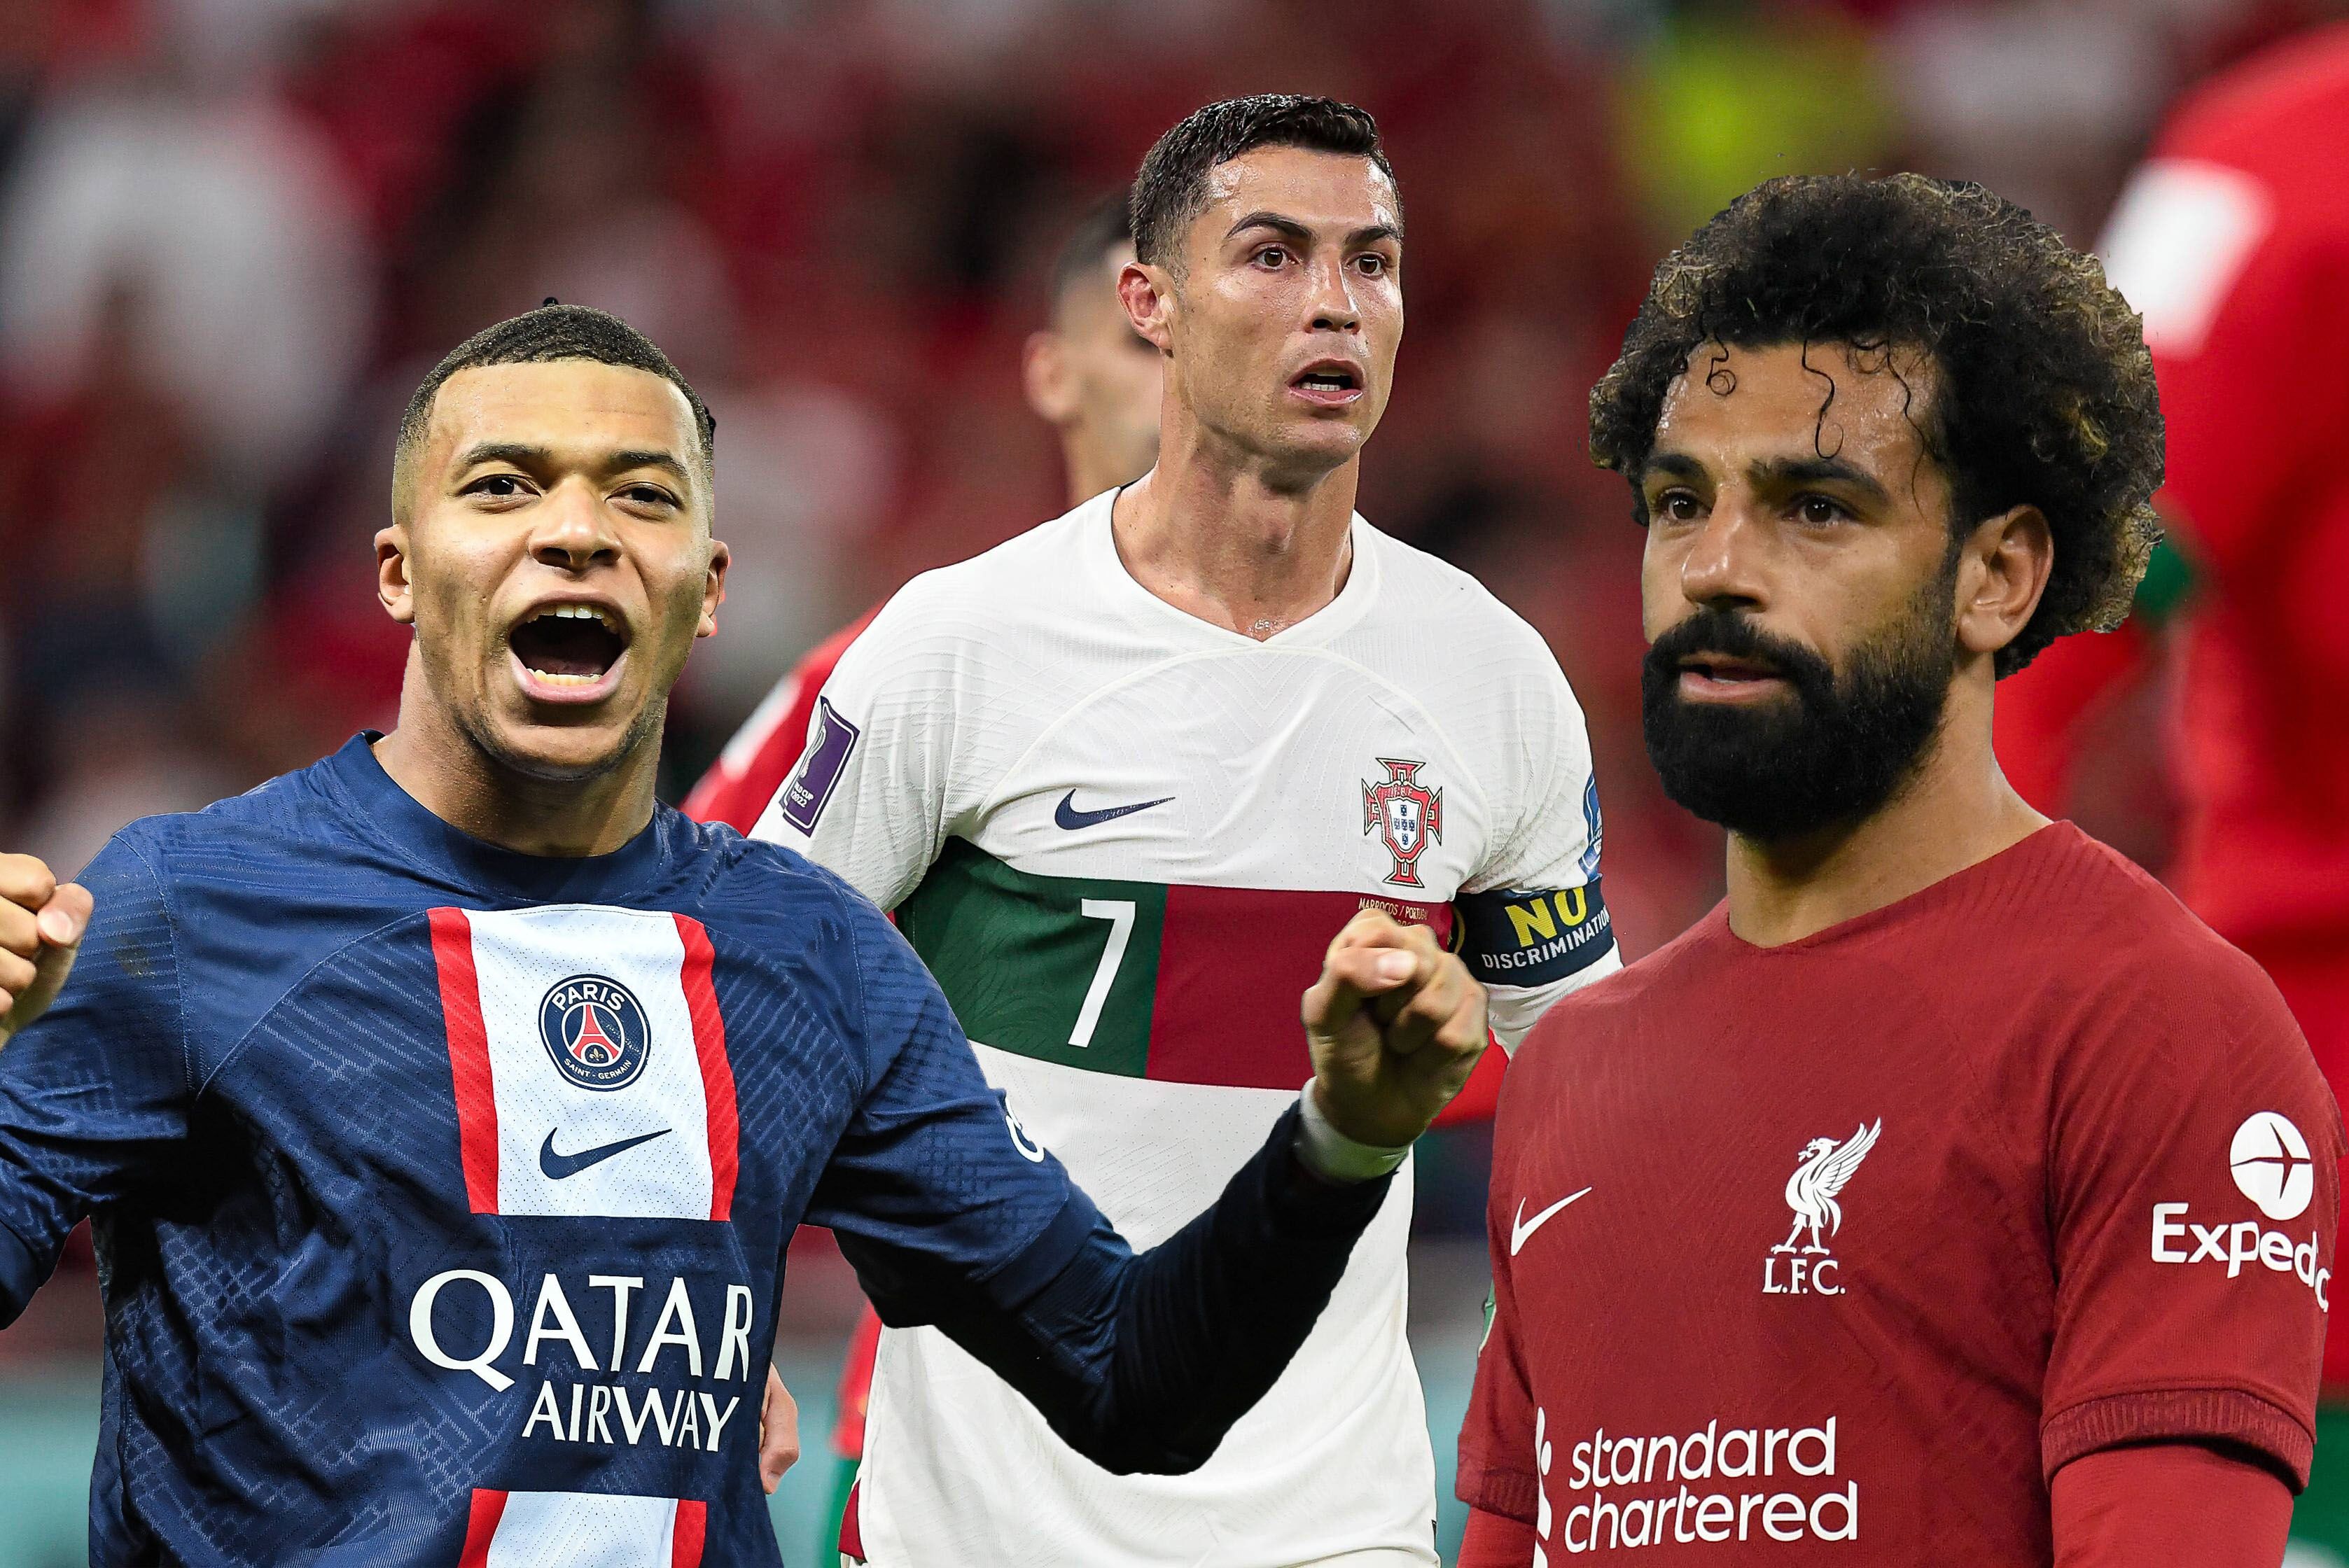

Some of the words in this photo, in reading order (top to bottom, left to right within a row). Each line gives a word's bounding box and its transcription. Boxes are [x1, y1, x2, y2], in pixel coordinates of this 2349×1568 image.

[1404, 906, 1428, 920] PORTU
[1482, 905, 1610, 969] DISCRIMINATION
[1505, 887, 1587, 947] NO
[552, 983, 625, 1011] PARIS
[1068, 898, 1136, 1048] 7
[1762, 1257, 1846, 1296] L.F.C.
[2152, 1202, 2331, 1313] Expeda
[409, 1269, 753, 1392] QATAR
[522, 1380, 740, 1452] AIRWAY
[1569, 1415, 1836, 1490] standard
[1564, 1479, 1858, 1553] chartered
